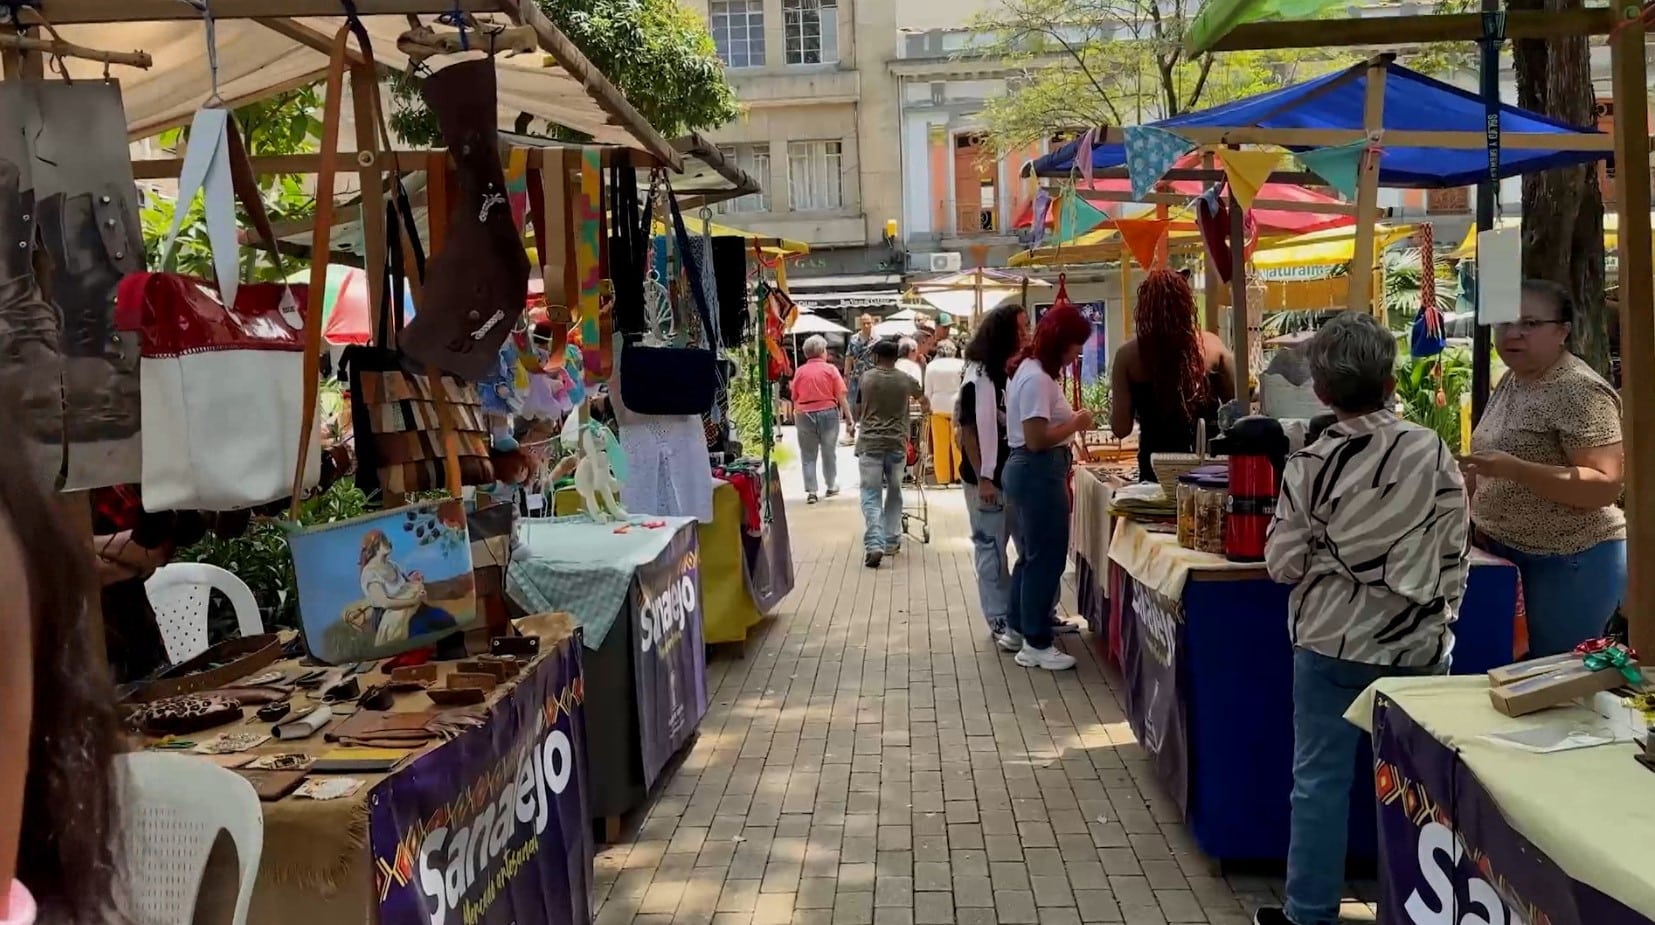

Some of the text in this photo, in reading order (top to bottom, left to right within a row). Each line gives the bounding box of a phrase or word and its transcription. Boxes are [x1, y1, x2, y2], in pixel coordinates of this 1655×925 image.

[463, 820, 539, 925] Mercado artesanal
[1404, 822, 1520, 925] Sa
